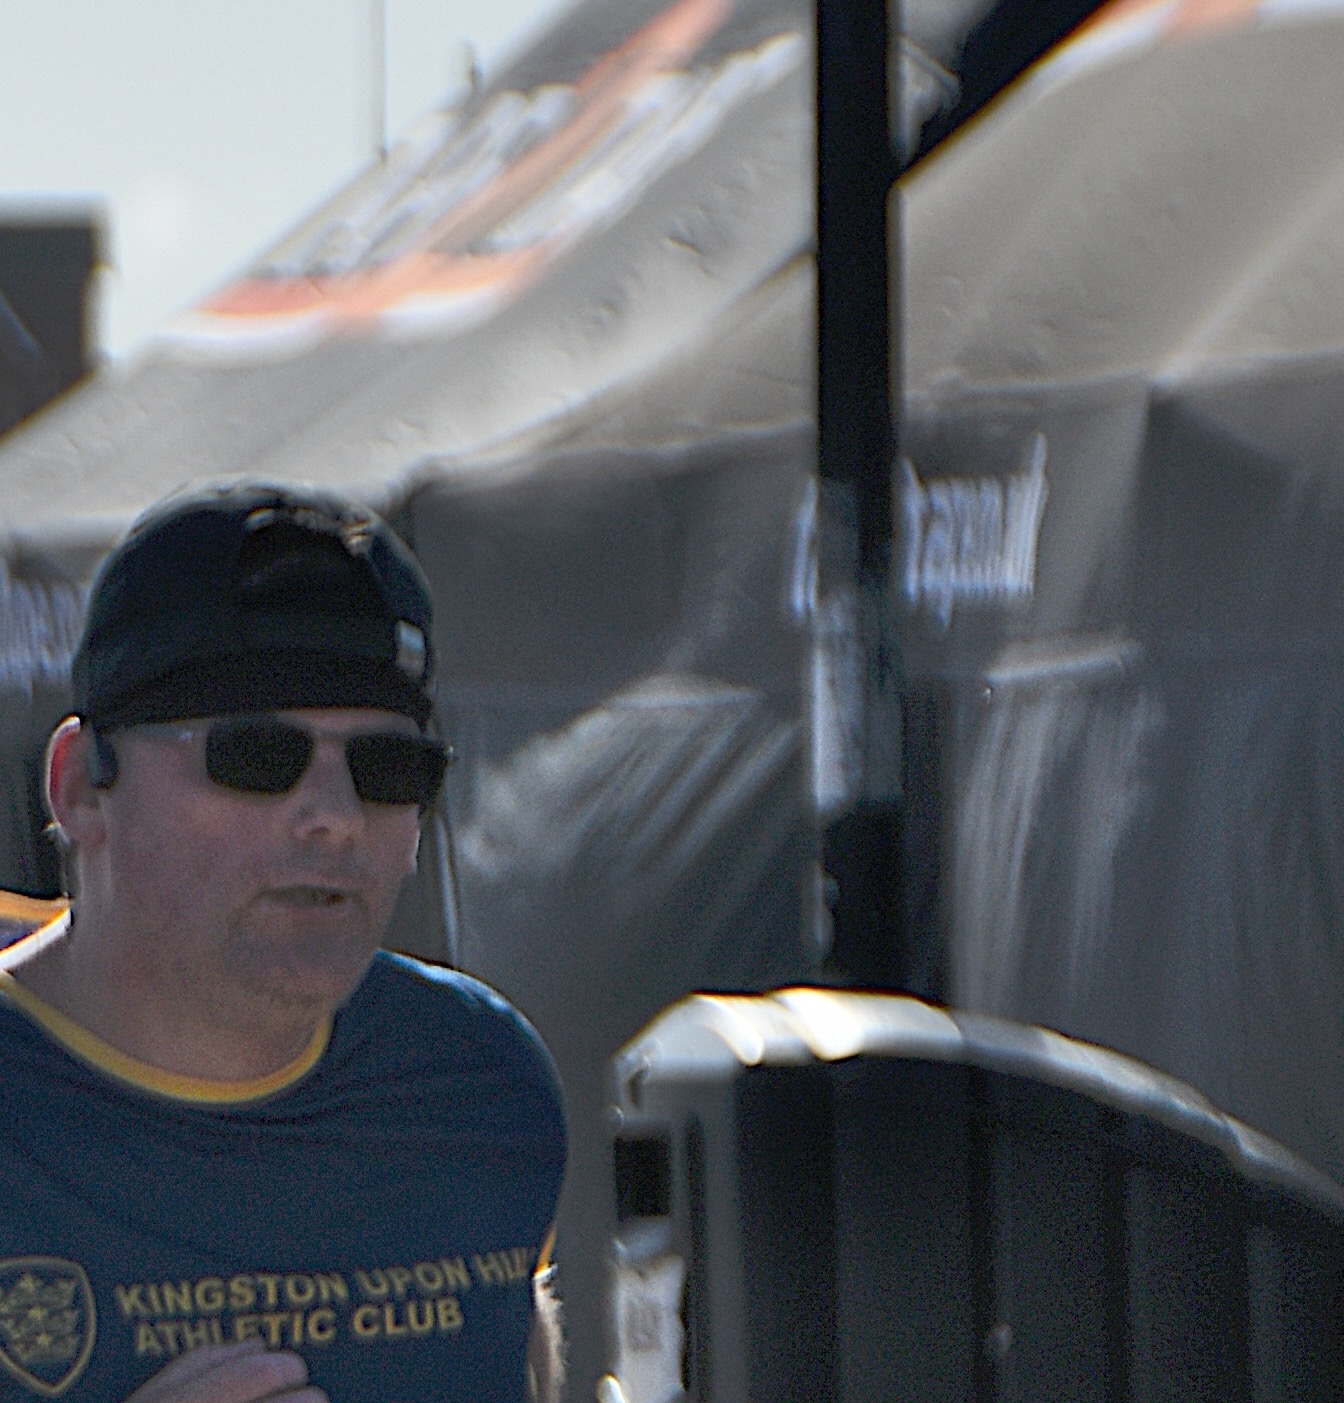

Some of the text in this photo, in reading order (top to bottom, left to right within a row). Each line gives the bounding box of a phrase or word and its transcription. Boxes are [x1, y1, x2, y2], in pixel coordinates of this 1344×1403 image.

[114, 1271, 350, 1316] KINGSTON
[360, 1256, 470, 1300] UPON
[354, 1299, 464, 1336] CLUB
